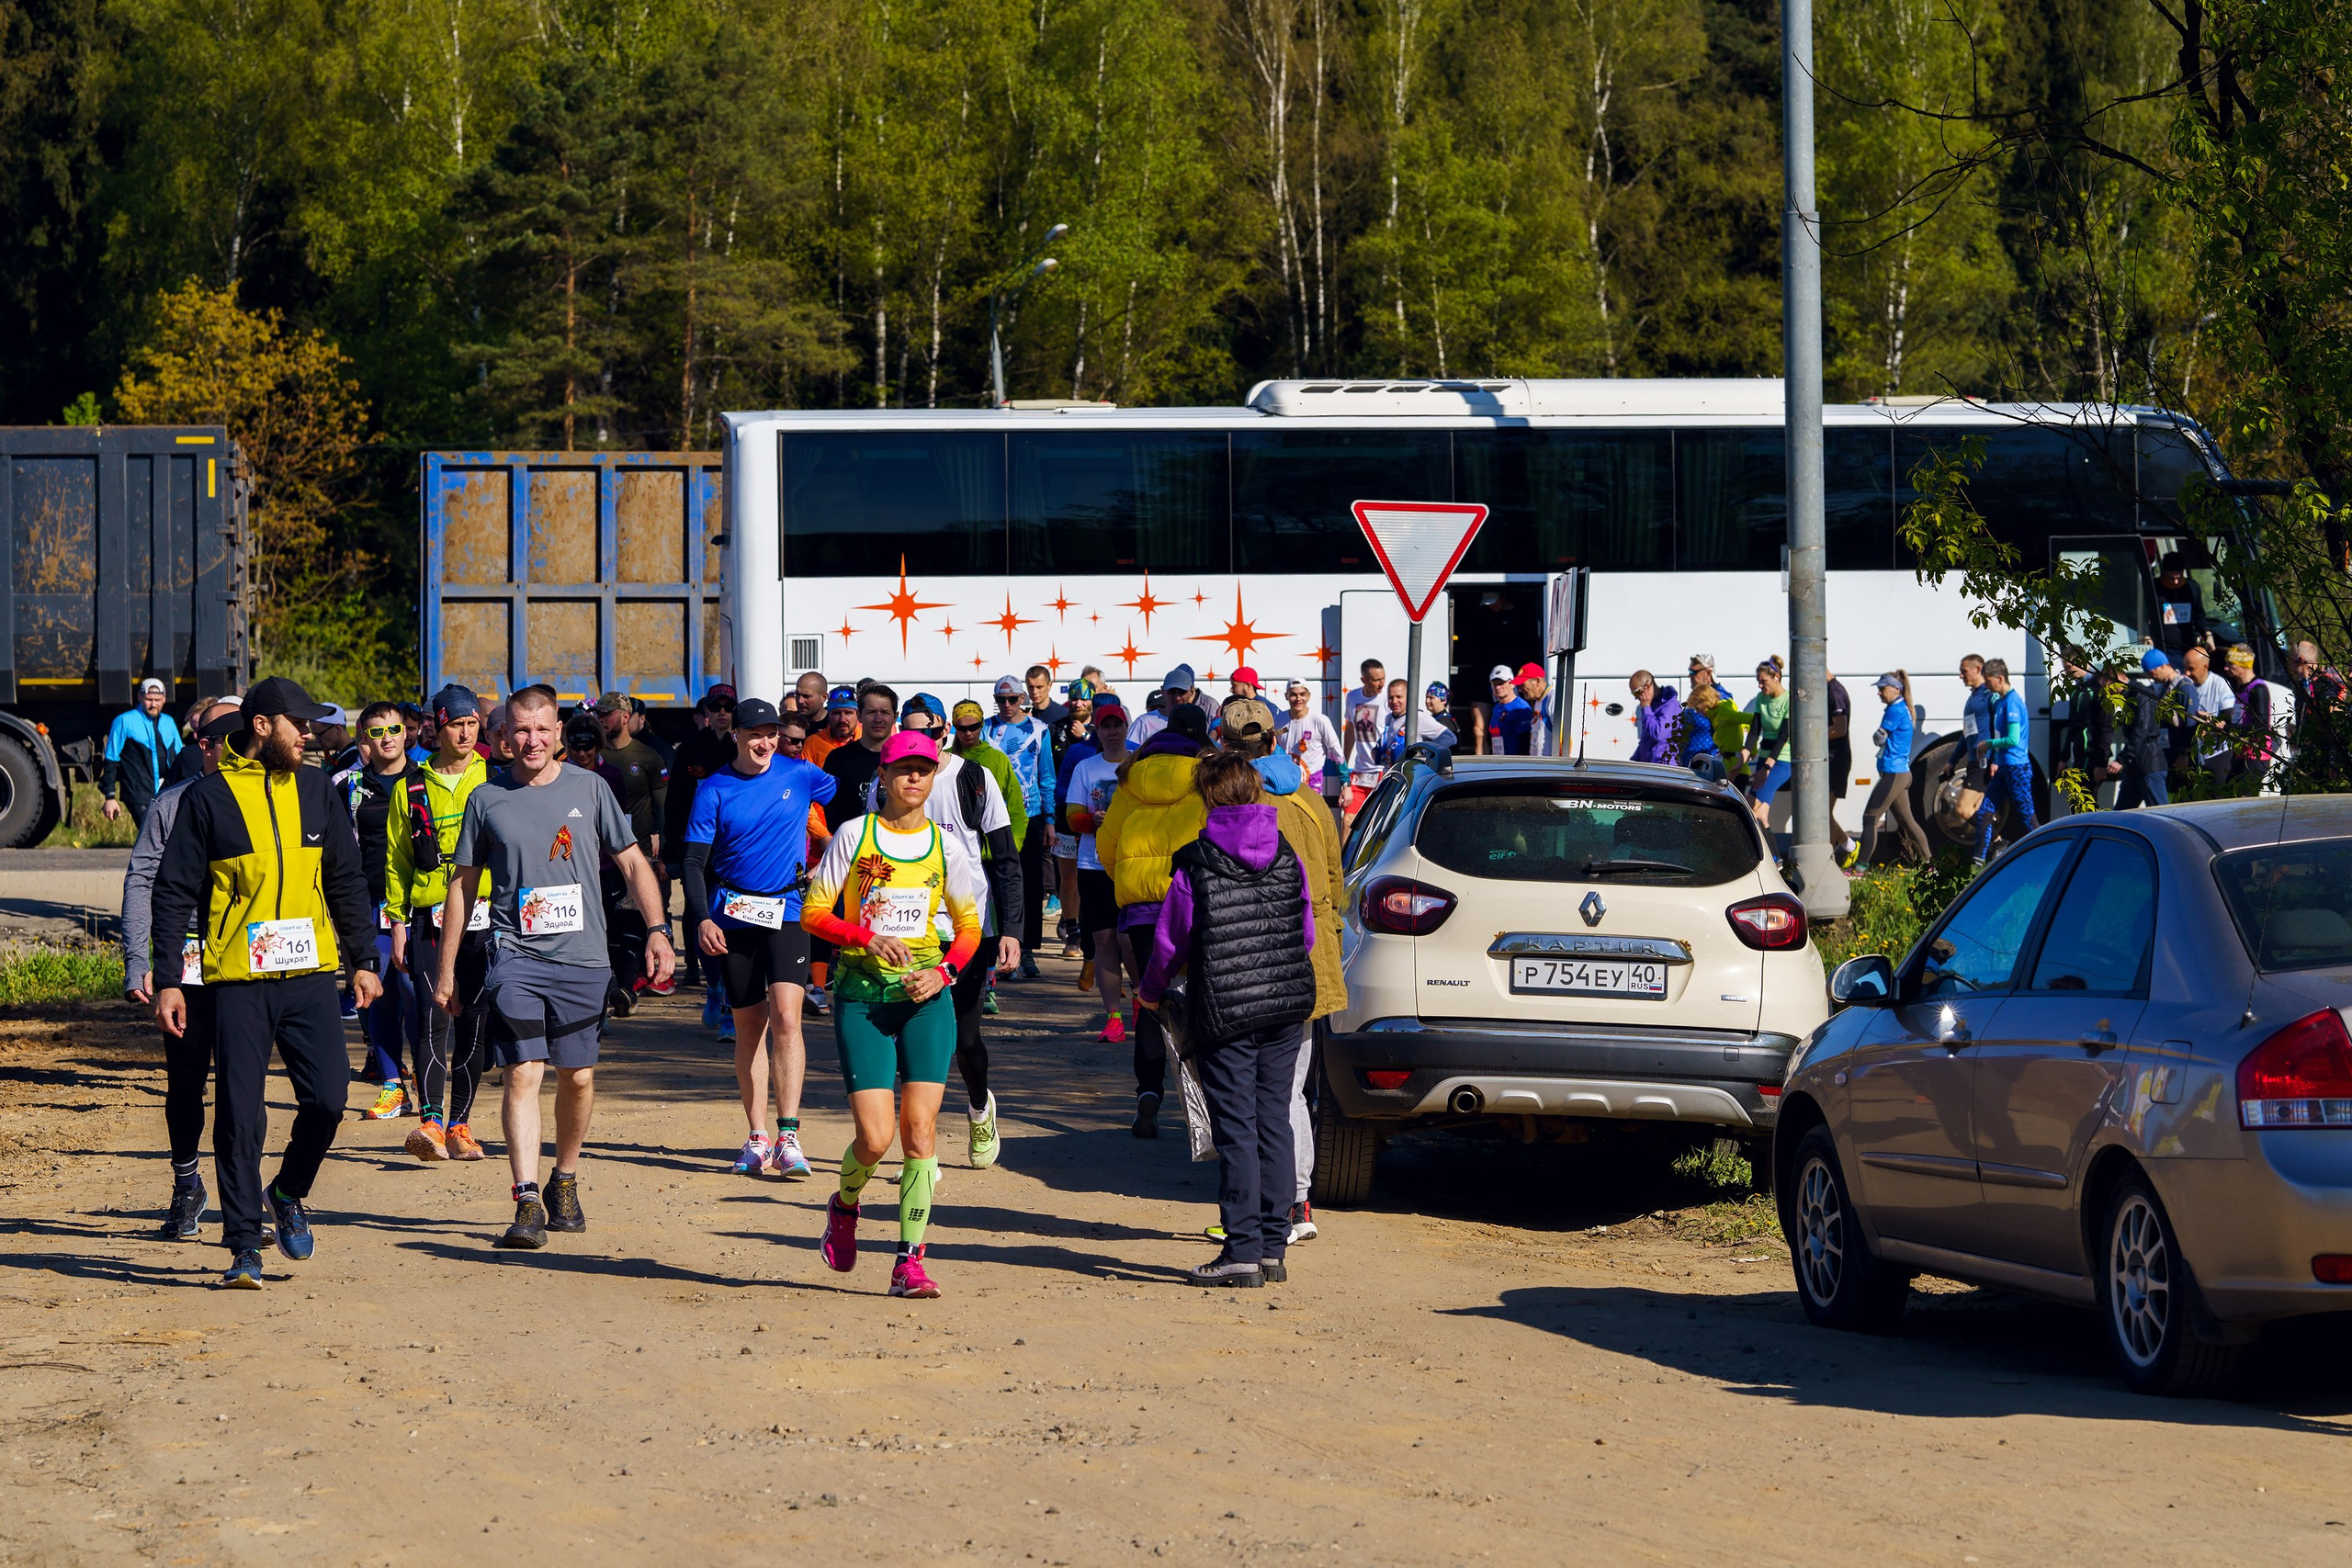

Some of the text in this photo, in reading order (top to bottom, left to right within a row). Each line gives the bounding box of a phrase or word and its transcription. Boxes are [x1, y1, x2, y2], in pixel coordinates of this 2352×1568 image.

[554, 904, 577, 919] 116
[757, 910, 774, 919] 63
[896, 908, 921, 922] 119
[544, 919, 573, 930] Эдуард
[881, 924, 915, 932] Любовь
[287, 939, 311, 954] 161
[1525, 938, 1657, 954] KAPTUR
[275, 956, 309, 965] Шухрат
[1632, 964, 1656, 983] 40
[1426, 979, 1471, 987] RENAULT
[1631, 982, 1649, 990] RUS
